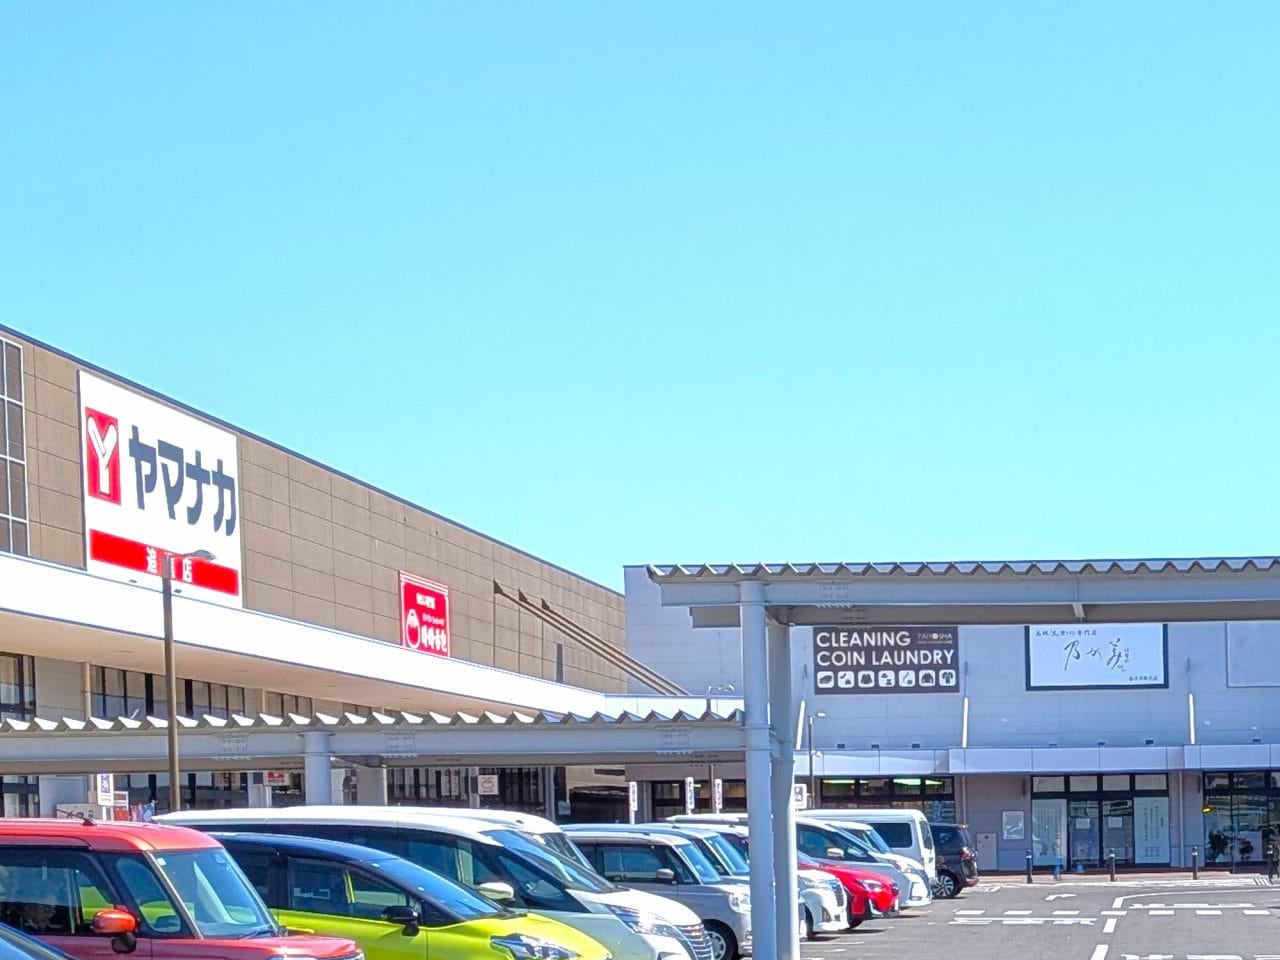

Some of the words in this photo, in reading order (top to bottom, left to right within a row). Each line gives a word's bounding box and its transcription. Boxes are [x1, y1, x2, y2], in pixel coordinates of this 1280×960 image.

[129, 424, 237, 536] ヤマナカ
[816, 631, 911, 647] CLEANING
[816, 651, 865, 666] COIN
[871, 649, 954, 665] LAUNDRY
